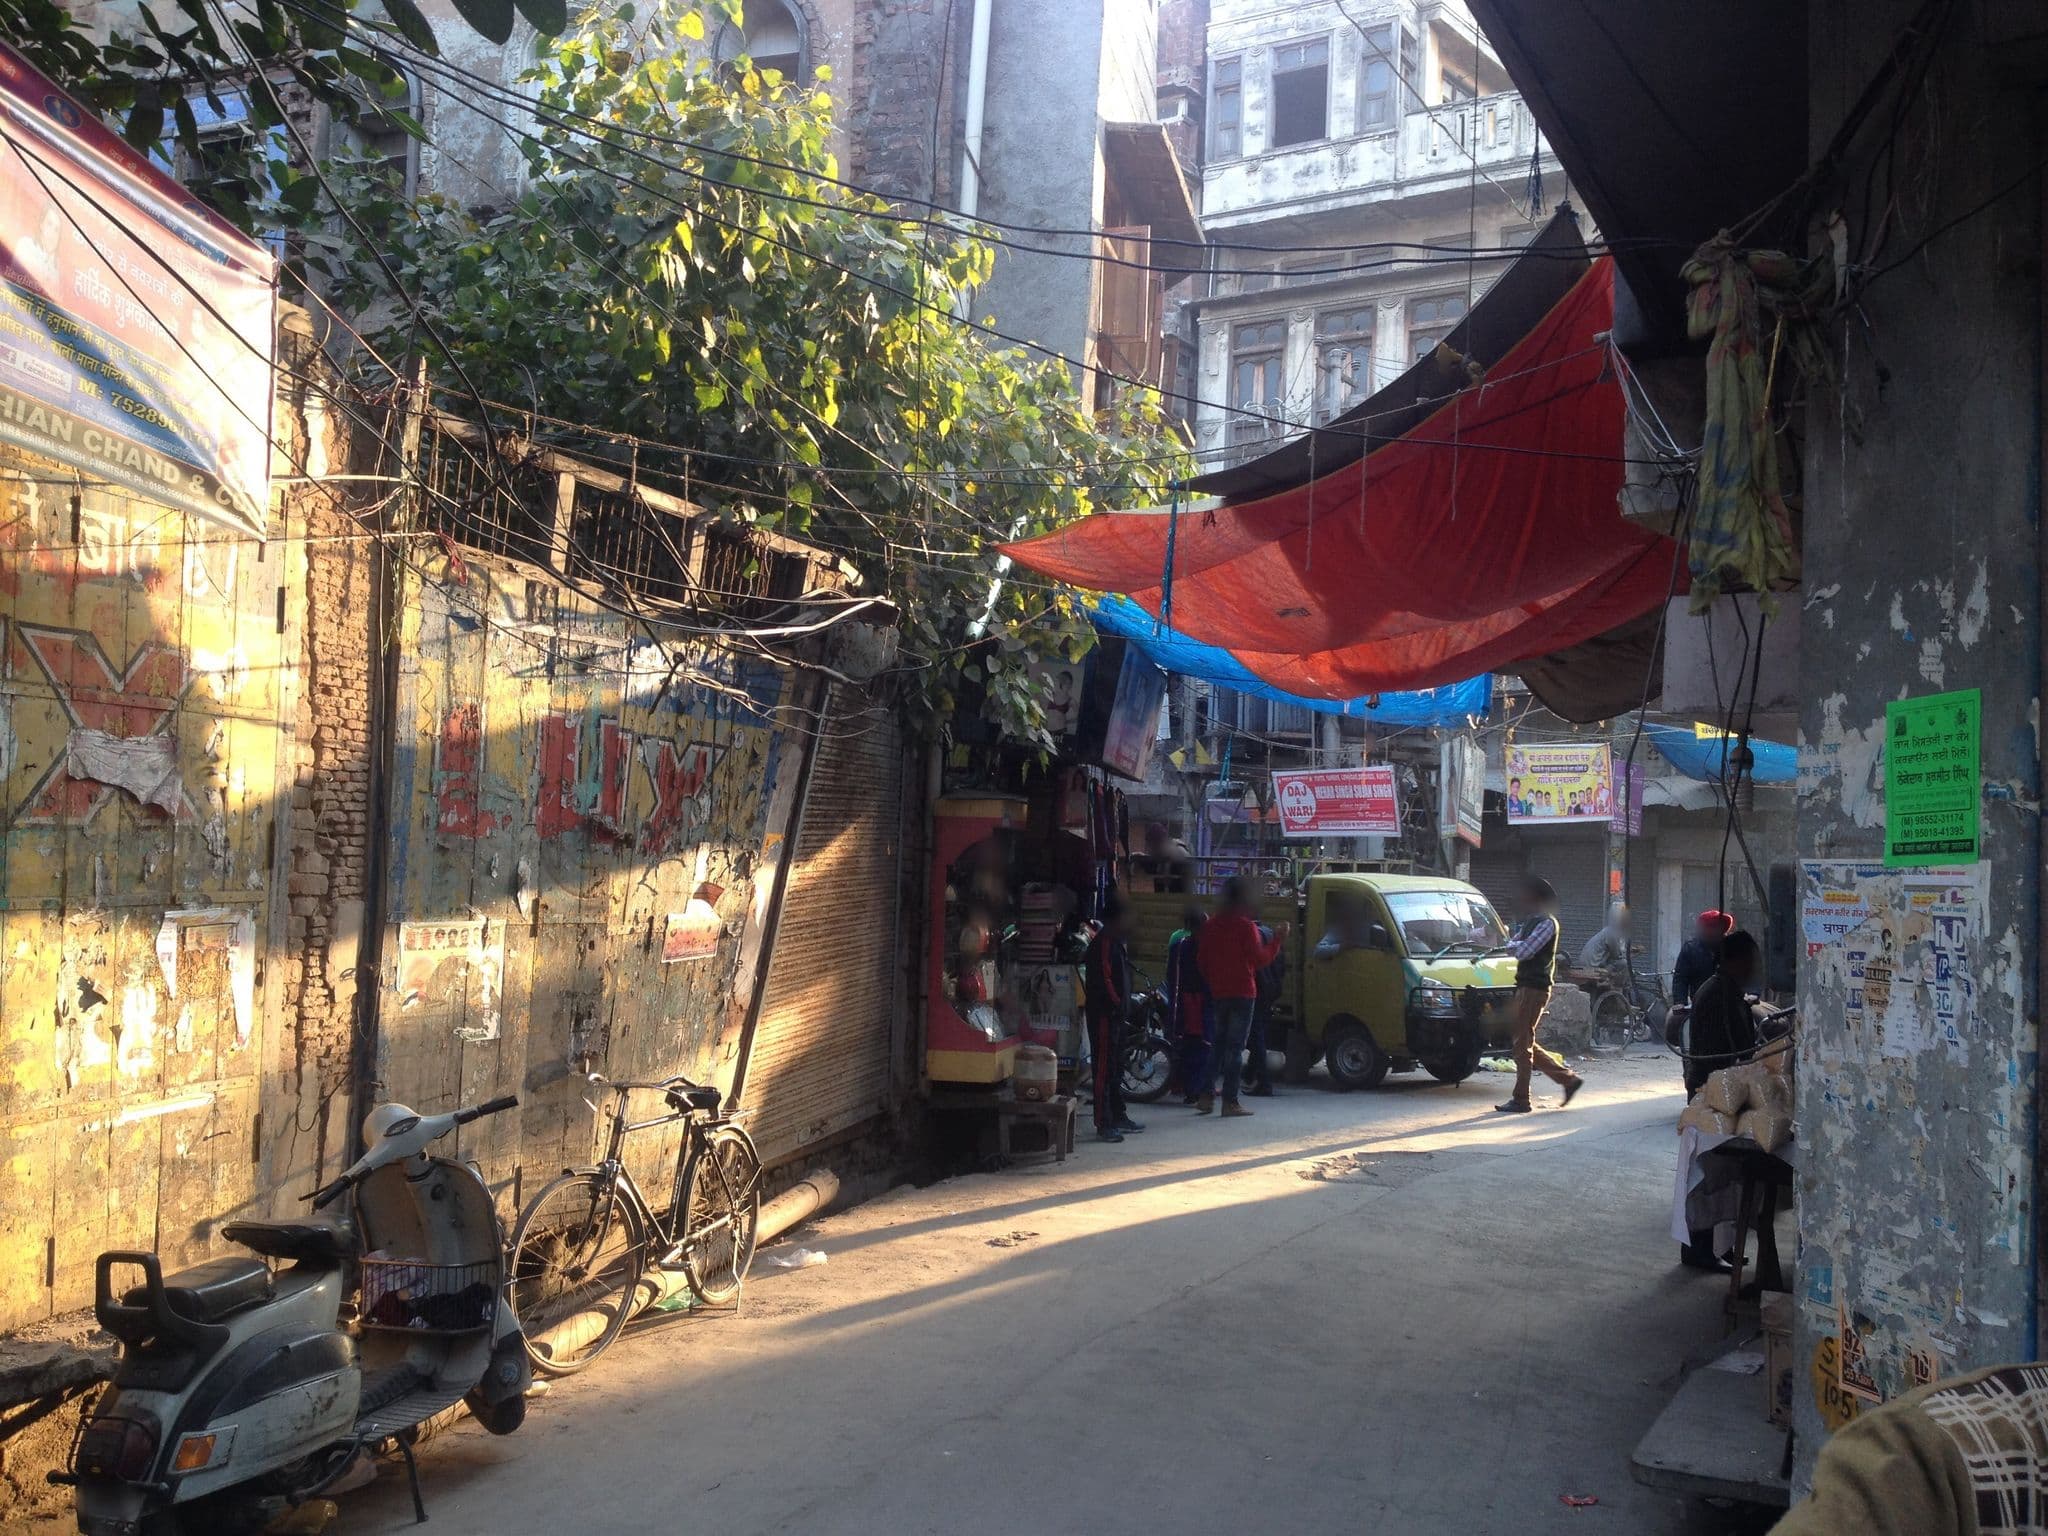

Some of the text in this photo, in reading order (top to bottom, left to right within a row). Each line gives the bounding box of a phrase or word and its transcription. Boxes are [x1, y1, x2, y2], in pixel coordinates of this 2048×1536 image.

[83, 429, 181, 485] CHAND
[430, 700, 728, 857] LUX
[1287, 785, 1307, 797] DAJ
[1287, 805, 1313, 817] WARI
[1901, 813, 1964, 827] (M) 98552-31174
[1900, 828, 1913, 839] (M)
